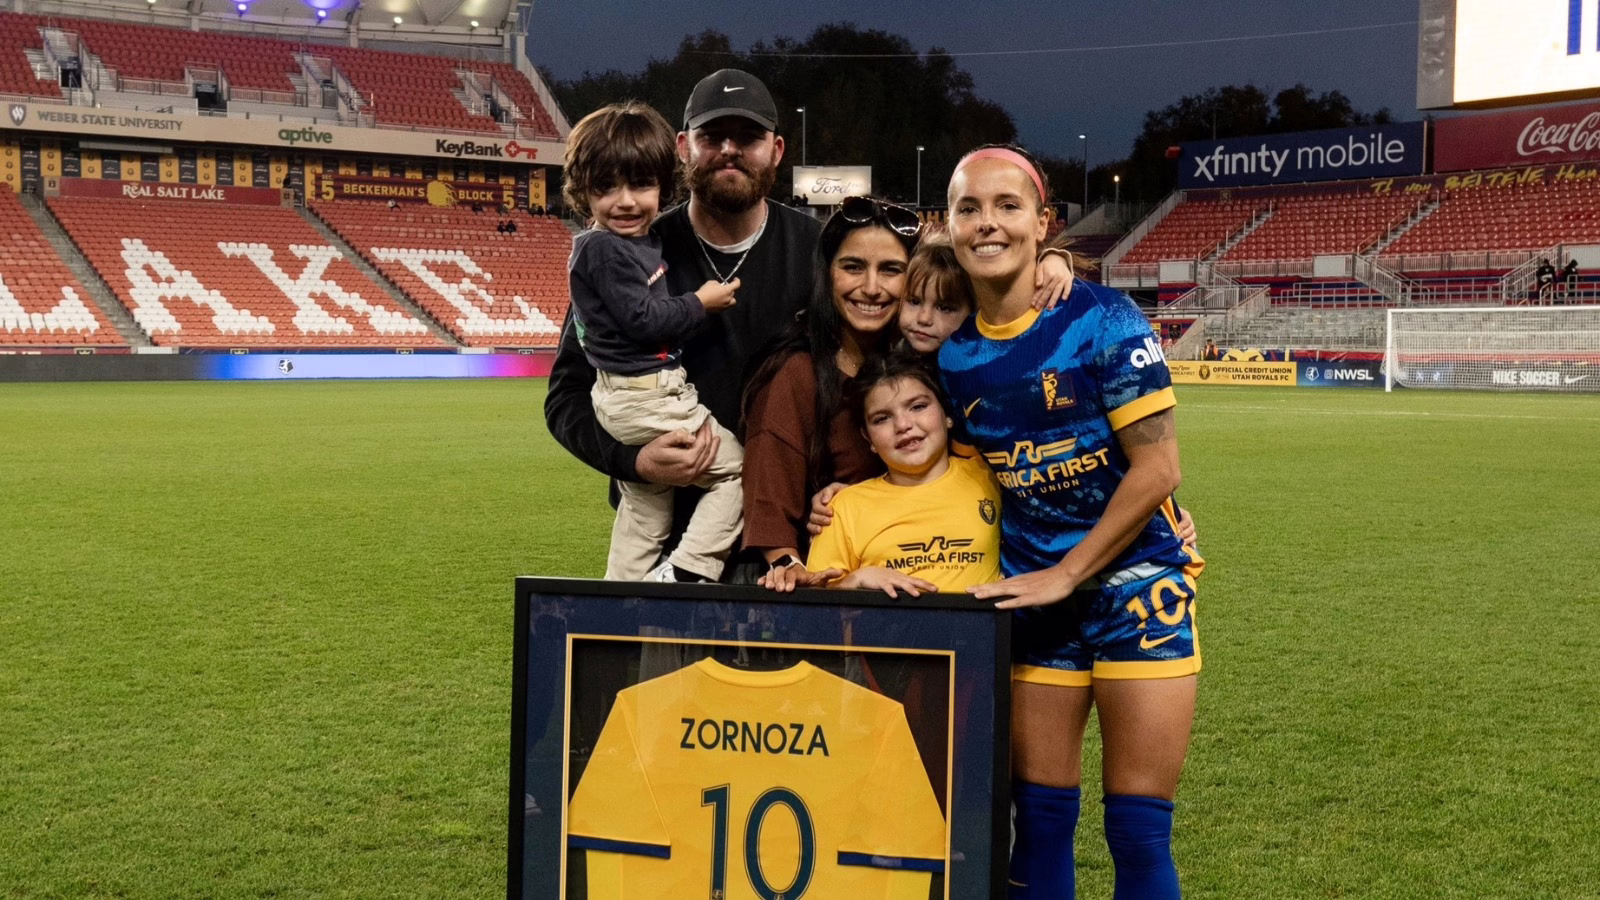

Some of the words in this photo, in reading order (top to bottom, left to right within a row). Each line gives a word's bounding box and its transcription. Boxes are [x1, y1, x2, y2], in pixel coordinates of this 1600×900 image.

[37, 111, 79, 124] WEBER
[82, 114, 116, 126] STATE
[119, 117, 183, 131] UNIVERSITY
[278, 126, 333, 146] aptive
[1516, 111, 1600, 156] Coca-Co
[436, 138, 503, 158] KeyBank
[1193, 144, 1290, 182] xfinity
[1297, 133, 1405, 169] mobile
[157, 187, 189, 199] SALT
[192, 184, 225, 200] LAKE
[321, 180, 335, 200] 5
[343, 183, 425, 198] BECKERMAN'S
[458, 190, 494, 201] BLOCK
[503, 190, 515, 210] 5
[811, 177, 852, 194] Ford
[1493, 370, 1518, 384] NIKE
[1519, 371, 1560, 385] SOCCER
[996, 467, 1046, 488] ERICA
[1046, 448, 1109, 481] FIRST
[1040, 479, 1080, 494] UNION
[885, 552, 946, 570] AMERICA
[948, 551, 985, 564] FIRST
[1125, 577, 1189, 630] 10
[679, 716, 830, 757] ZORNOZA
[700, 782, 817, 900] 10
